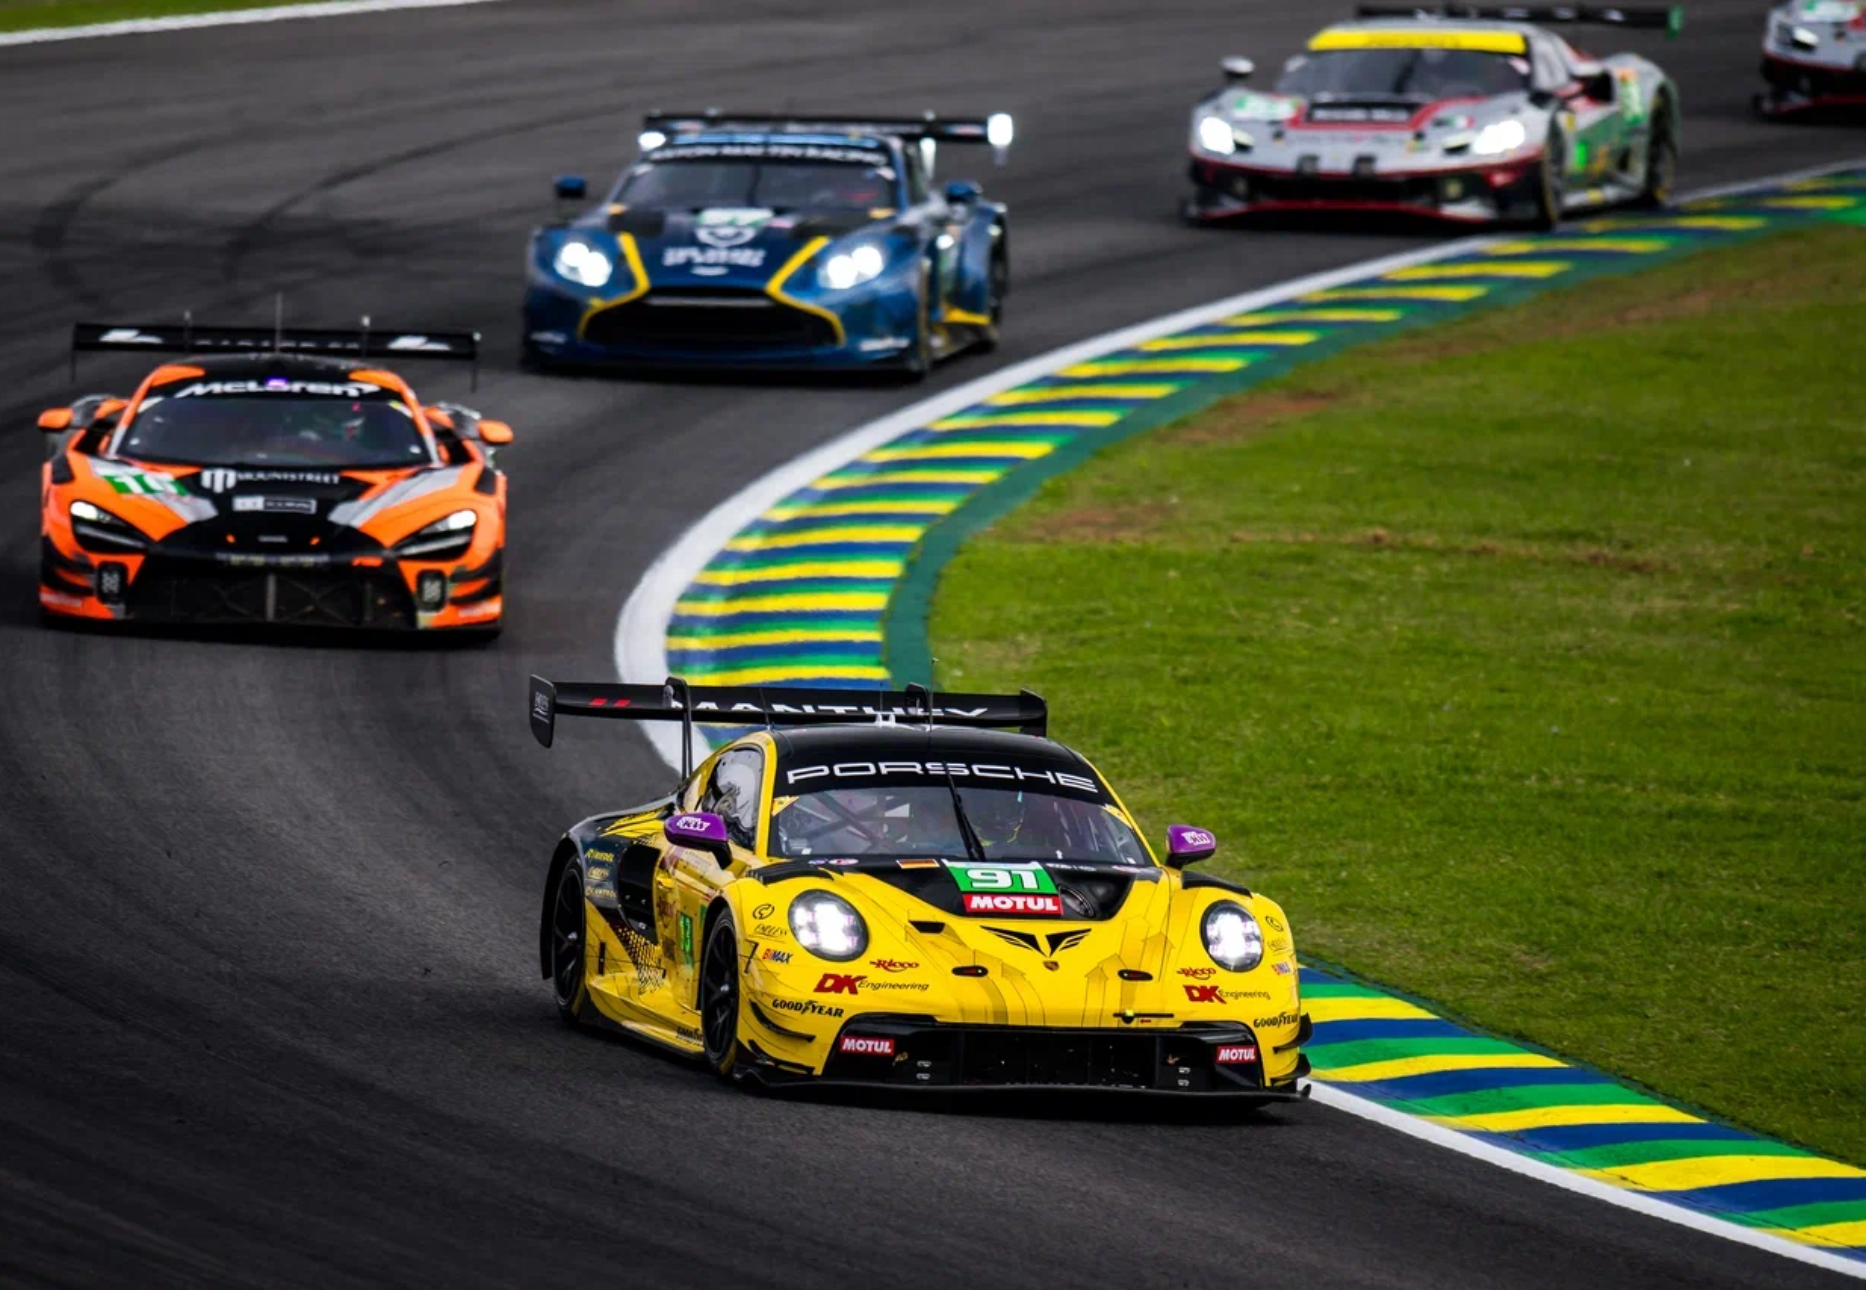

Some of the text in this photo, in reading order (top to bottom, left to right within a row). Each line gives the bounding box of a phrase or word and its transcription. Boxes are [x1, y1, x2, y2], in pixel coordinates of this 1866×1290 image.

[786, 761, 1099, 794] PORSCHE
[966, 869, 1040, 890] 91
[970, 895, 1059, 911] MOTUL
[813, 973, 930, 995] DK Engineering
[1182, 984, 1227, 1005] DK
[772, 998, 845, 1018] GOODYEAR
[841, 1038, 893, 1054] MOTUL
[1218, 1047, 1256, 1062] MOTUL
